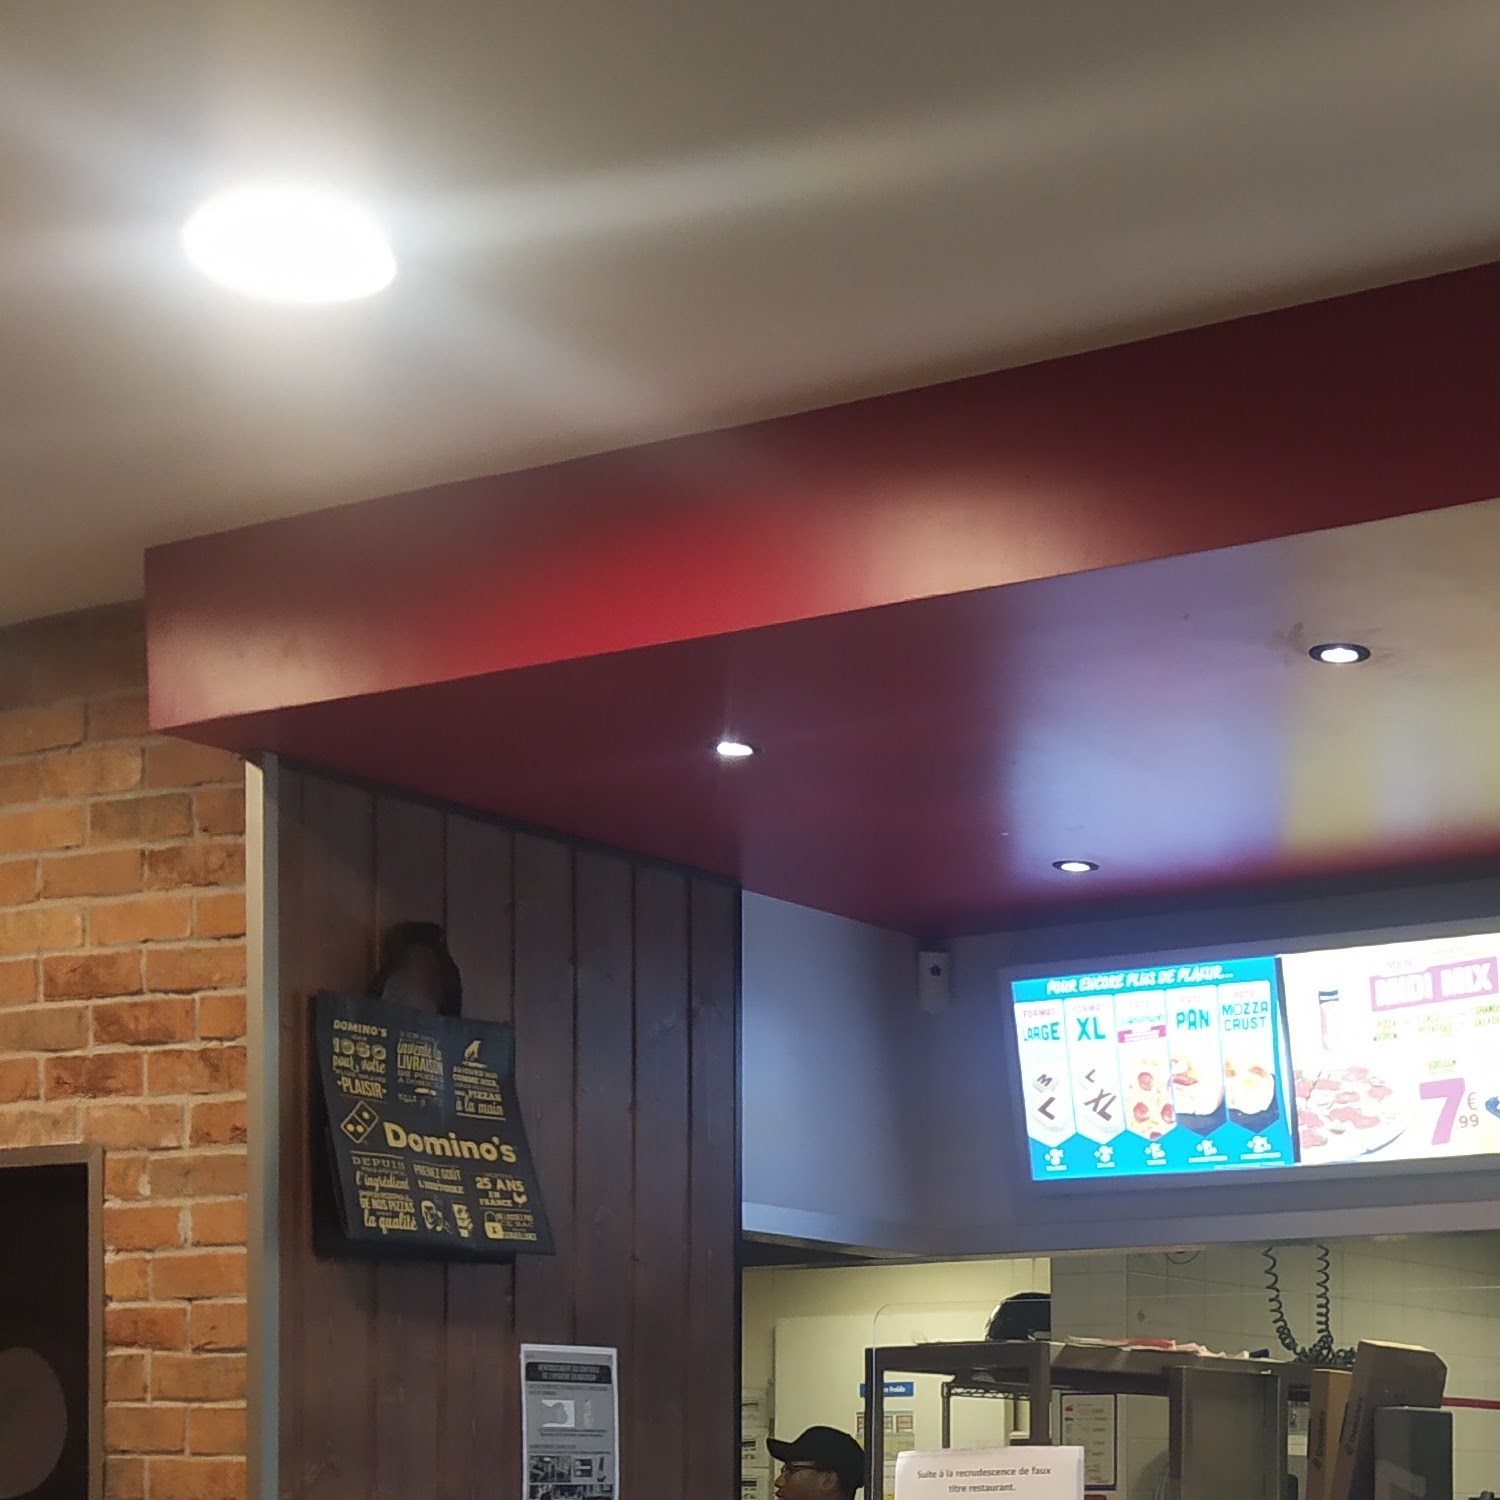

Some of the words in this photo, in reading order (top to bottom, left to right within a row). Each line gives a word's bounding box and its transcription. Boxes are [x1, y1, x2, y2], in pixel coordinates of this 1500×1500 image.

[1375, 971, 1434, 1007] MIDI
[1440, 962, 1493, 997] MIX
[1221, 1001, 1269, 1016] MOZZA
[332, 1019, 388, 1038] DOMINO'S
[1076, 1016, 1107, 1041] XL
[1176, 1009, 1210, 1031] PAN
[1224, 1016, 1267, 1031] CRUST
[1022, 1021, 1060, 1041] LARGE
[341, 1076, 385, 1098] PLAISIR
[1083, 1088, 1117, 1122] XL
[1419, 1077, 1466, 1145] 7
[383, 1121, 518, 1163] Domino's
[352, 1156, 405, 1169] DEPUIS
[475, 1176, 492, 1190] 25
[496, 1178, 526, 1192] ANS
[917, 1469, 937, 1479] Suite
[946, 1468, 954, 1478] la
[955, 1467, 1017, 1478] recrudescence
[1018, 1466, 1029, 1476] de
[1031, 1466, 1052, 1476] faux
[948, 1484, 967, 1494] titre
[968, 1483, 1017, 1493] restaurant.
